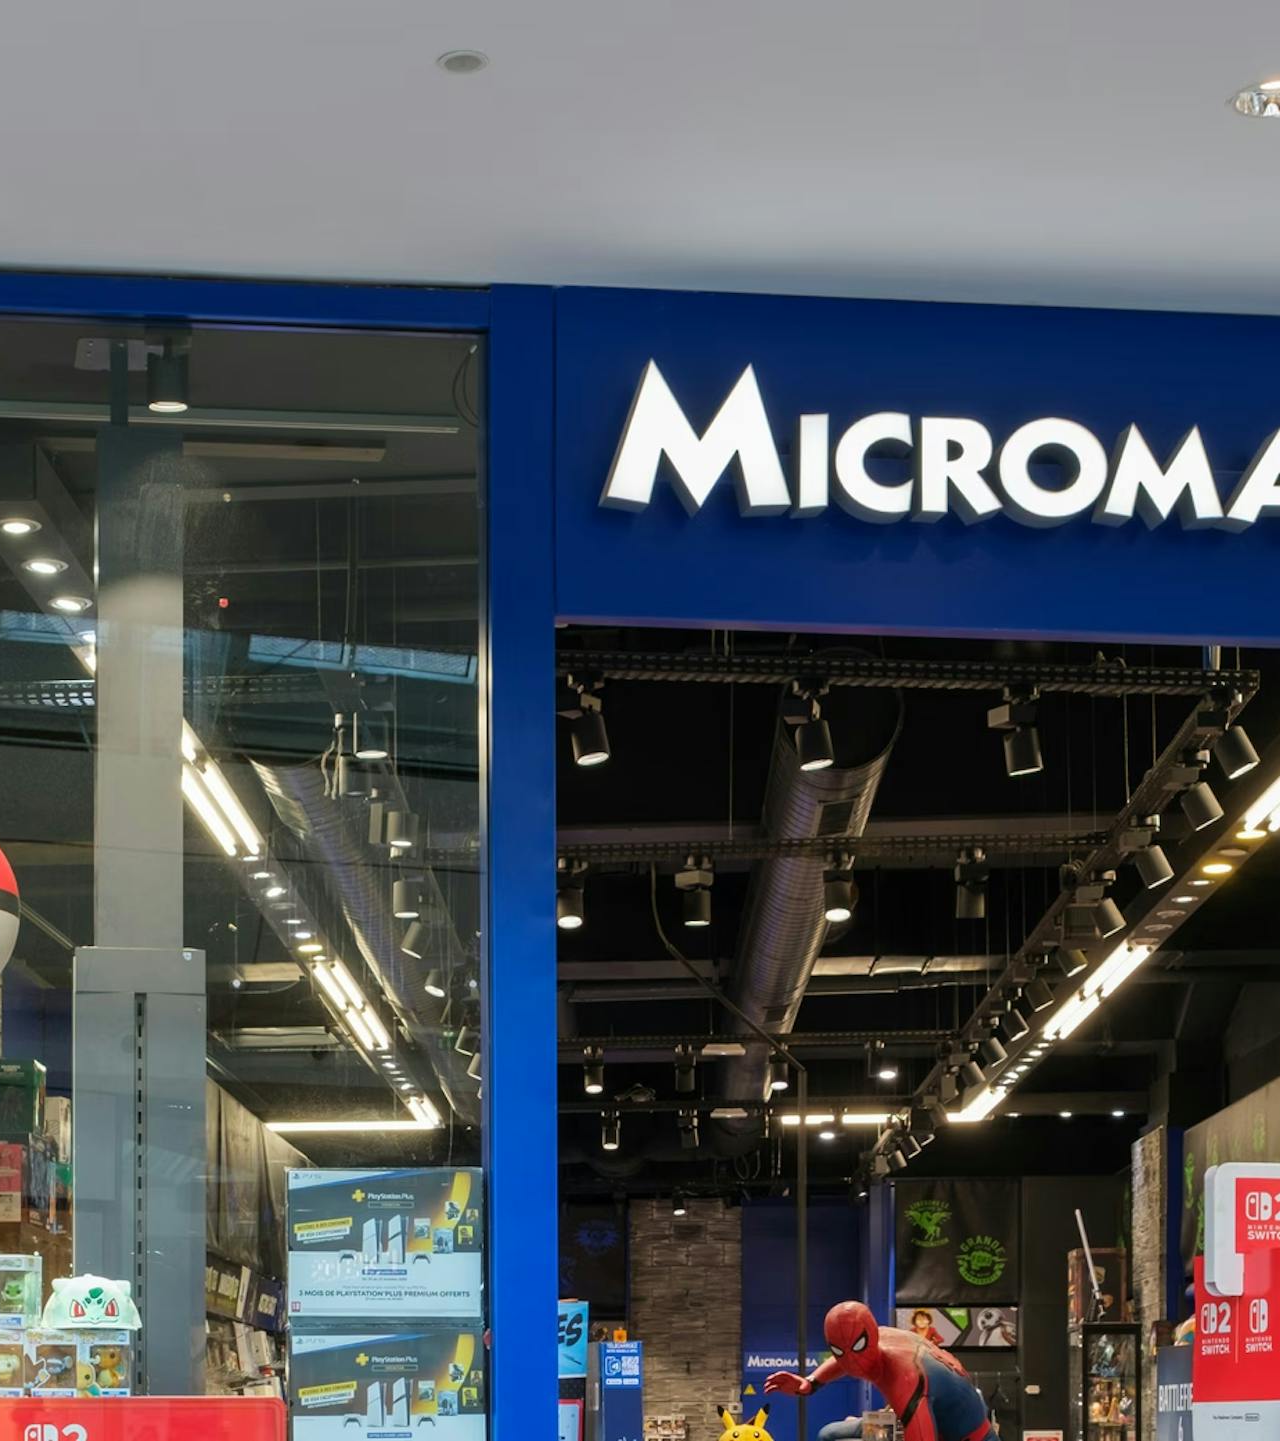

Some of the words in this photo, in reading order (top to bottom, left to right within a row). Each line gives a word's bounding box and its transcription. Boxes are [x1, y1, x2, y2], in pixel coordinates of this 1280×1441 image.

[368, 1193, 401, 1202] PlayStation
[1218, 1302, 1231, 1333] 2
[1202, 1344, 1230, 1355] SWITCH
[1245, 1343, 1272, 1353] SWITCH
[371, 1356, 405, 1365] PlayStation
